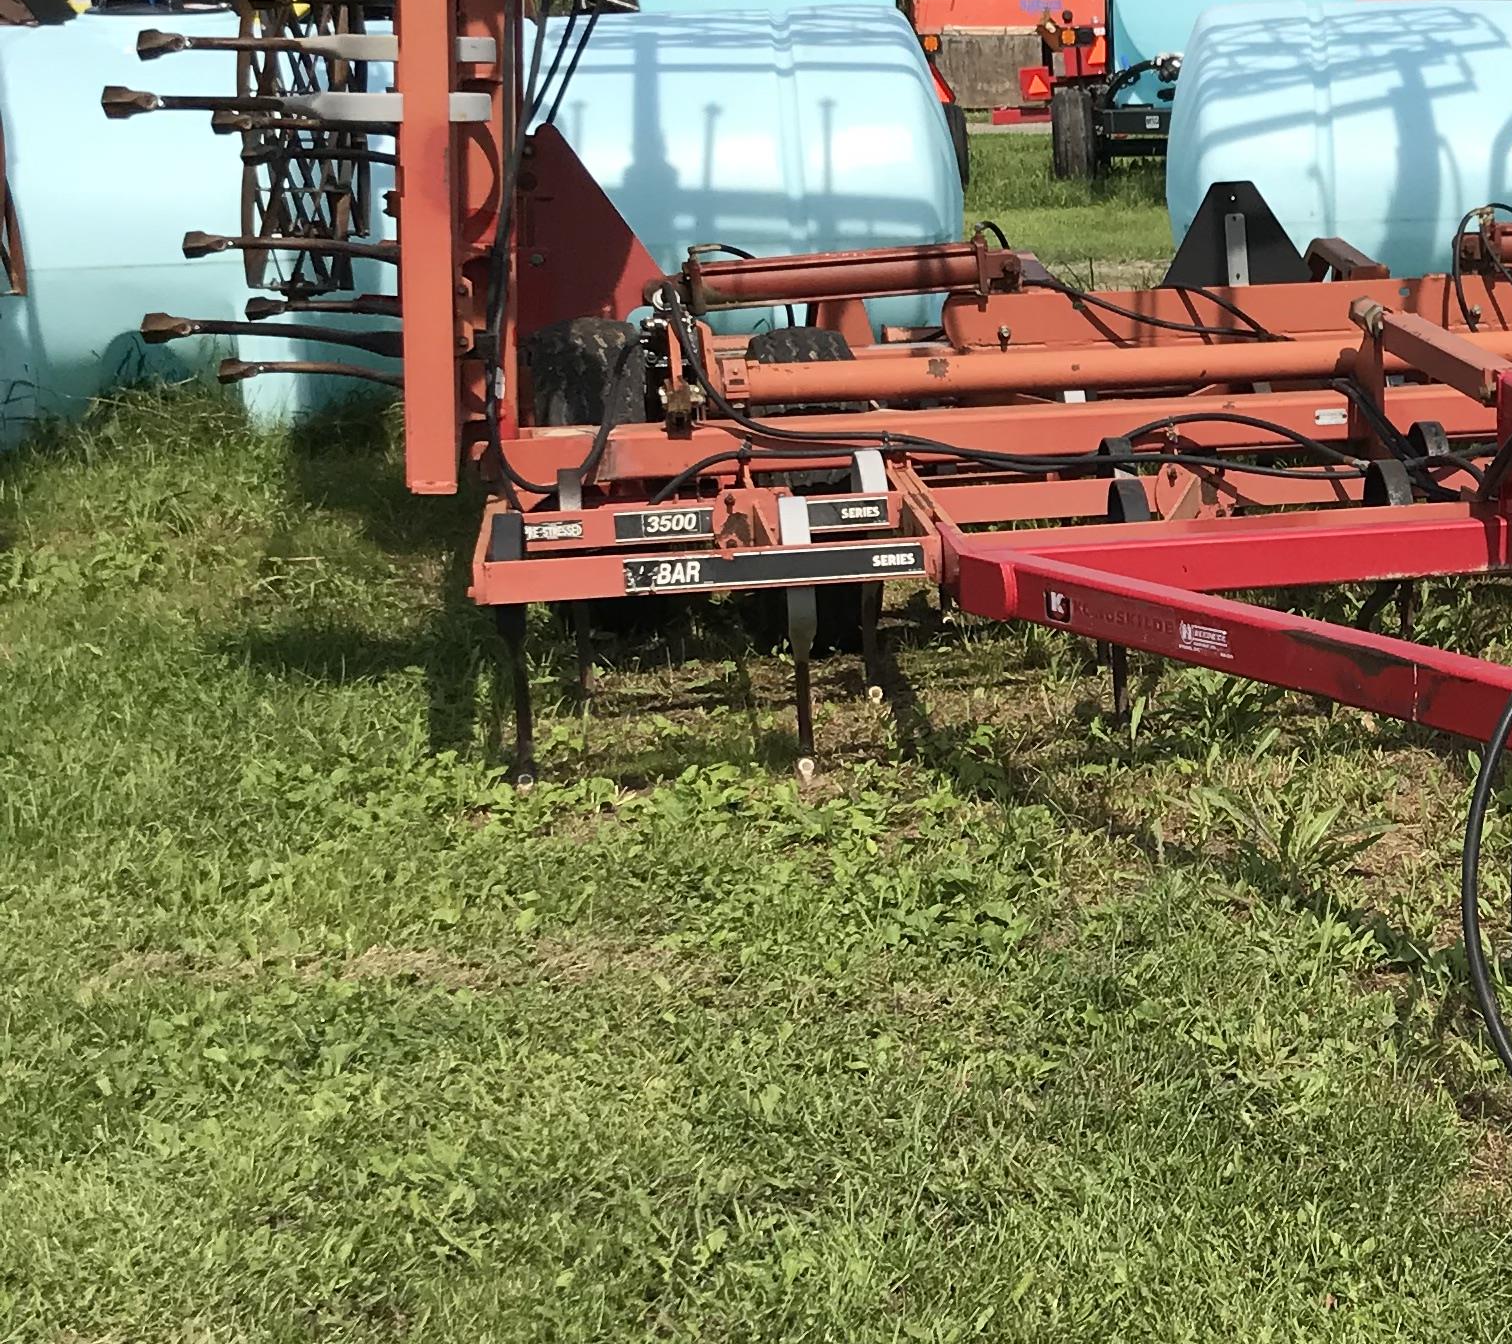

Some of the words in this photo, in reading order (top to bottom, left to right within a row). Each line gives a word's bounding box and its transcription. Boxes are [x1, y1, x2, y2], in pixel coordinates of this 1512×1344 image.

[841, 506, 880, 519] SERIES
[646, 513, 697, 533] 3500
[872, 553, 915, 567] SERIES
